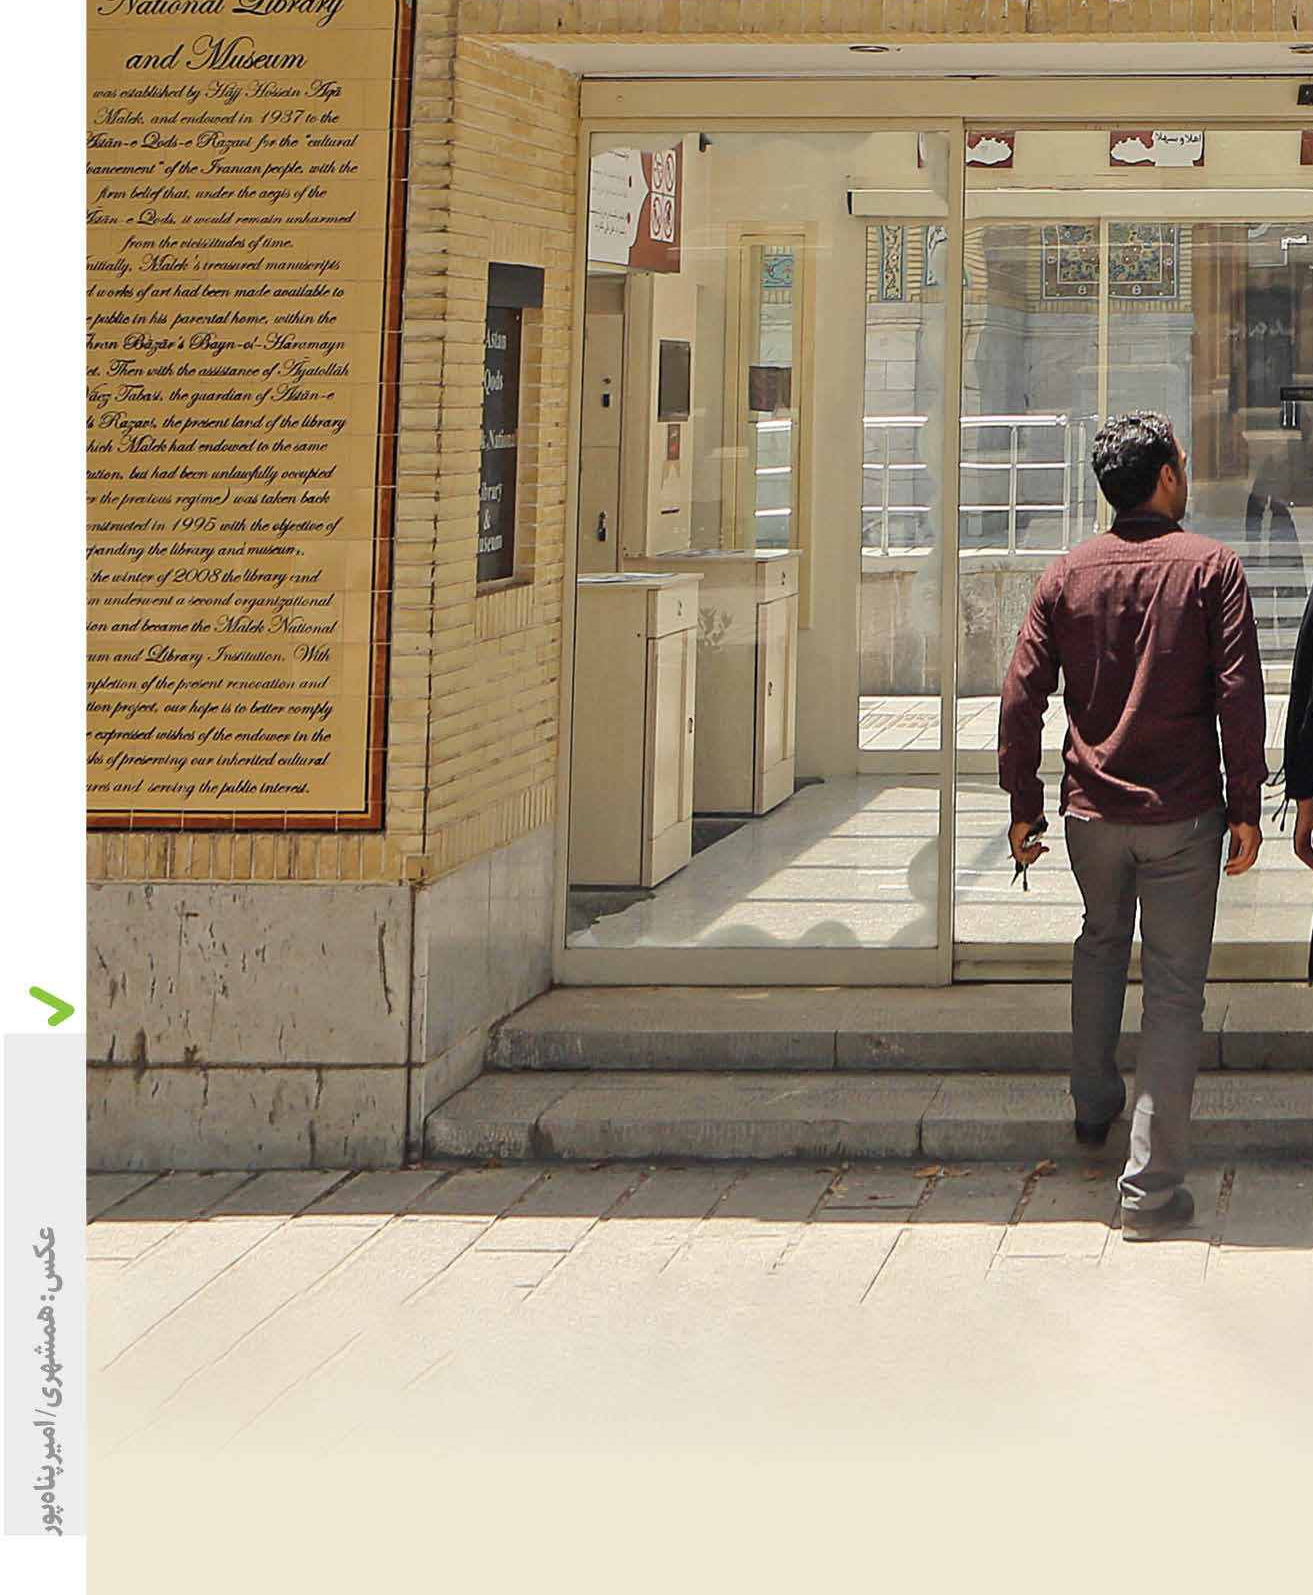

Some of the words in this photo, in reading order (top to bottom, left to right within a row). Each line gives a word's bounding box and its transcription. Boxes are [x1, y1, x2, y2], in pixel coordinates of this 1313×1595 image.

[126, 44, 185, 69] and
[186, 35, 307, 69] Museum
[92, 88, 117, 98] was
[120, 86, 188, 98] established
[186, 86, 200, 103] by
[151, 111, 177, 123] and
[180, 111, 236, 124] endowed
[260, 110, 305, 123] 1937
[320, 110, 339, 123] the
[180, 161, 198, 173] the
[200, 158, 261, 174] Iranian
[309, 161, 337, 174] with
[339, 160, 358, 173] the
[95, 186, 127, 204] firm
[130, 184, 162, 204] belief
[196, 186, 234, 199] under
[237, 185, 256, 198] the
[259, 187, 291, 205] aegis
[309, 184, 327, 198] the
[193, 211, 234, 224] would
[235, 214, 282, 224] remain
[286, 211, 356, 224] unharmed
[120, 235, 157, 254] from
[158, 235, 177, 248] the
[180, 235, 245, 248] vicissitudes
[263, 235, 294, 248] time.
[203, 259, 262, 270] treasured
[265, 259, 340, 276] manuscripts
[97, 286, 133, 297] works
[151, 286, 172, 297] art
[173, 284, 199, 297] had
[202, 284, 230, 297] been
[234, 284, 270, 297] made
[274, 285, 329, 297] available
[90, 311, 129, 330] public
[149, 311, 168, 324] his
[171, 312, 228, 330] parental
[274, 311, 314, 324] within
[318, 311, 337, 324] the
[107, 359, 143, 376] Then
[146, 363, 174, 376] with
[177, 363, 196, 376] the
[198, 365, 260, 376] assistance
[484, 369, 503, 395] Qods
[162, 414, 182, 428] the
[179, 416, 230, 434] present
[231, 414, 265, 428] land
[280, 414, 299, 428] the
[301, 414, 347, 435] library
[117, 434, 167, 453] Malek
[168, 439, 195, 452] had
[199, 439, 256, 452] endowed
[272, 439, 291, 451] the
[293, 443, 327, 452] same
[233, 495, 258, 504] was
[261, 491, 296, 504] taken
[300, 491, 330, 504] back
[480, 481, 502, 502] ibrary
[171, 517, 218, 532] 1995
[219, 518, 247, 531] with
[250, 518, 269, 531] the
[272, 518, 323, 538] objective
[483, 509, 490, 530] &
[480, 534, 502, 552] useum
[90, 569, 110, 582] the
[112, 571, 154, 582] winter
[172, 568, 222, 583] 2008
[222, 569, 240, 582] the
[242, 569, 287, 589] library
[290, 569, 323, 583] and
[111, 618, 143, 631] and
[141, 619, 189, 631] became
[190, 619, 211, 631] the
[213, 615, 266, 633] Malek
[268, 616, 339, 633] National
[114, 649, 145, 662] and
[145, 643, 203, 668] Library
[207, 645, 286, 663] Institution.
[293, 645, 330, 662] With
[95, 727, 157, 745] expressed
[156, 728, 195, 741] wishes
[213, 728, 232, 741] the
[235, 728, 291, 741] endower
[312, 728, 331, 742] the
[114, 779, 144, 792] and
[147, 782, 196, 799] serving
[199, 779, 219, 793] the
[216, 780, 257, 799] public
[260, 781, 310, 794] interest.
